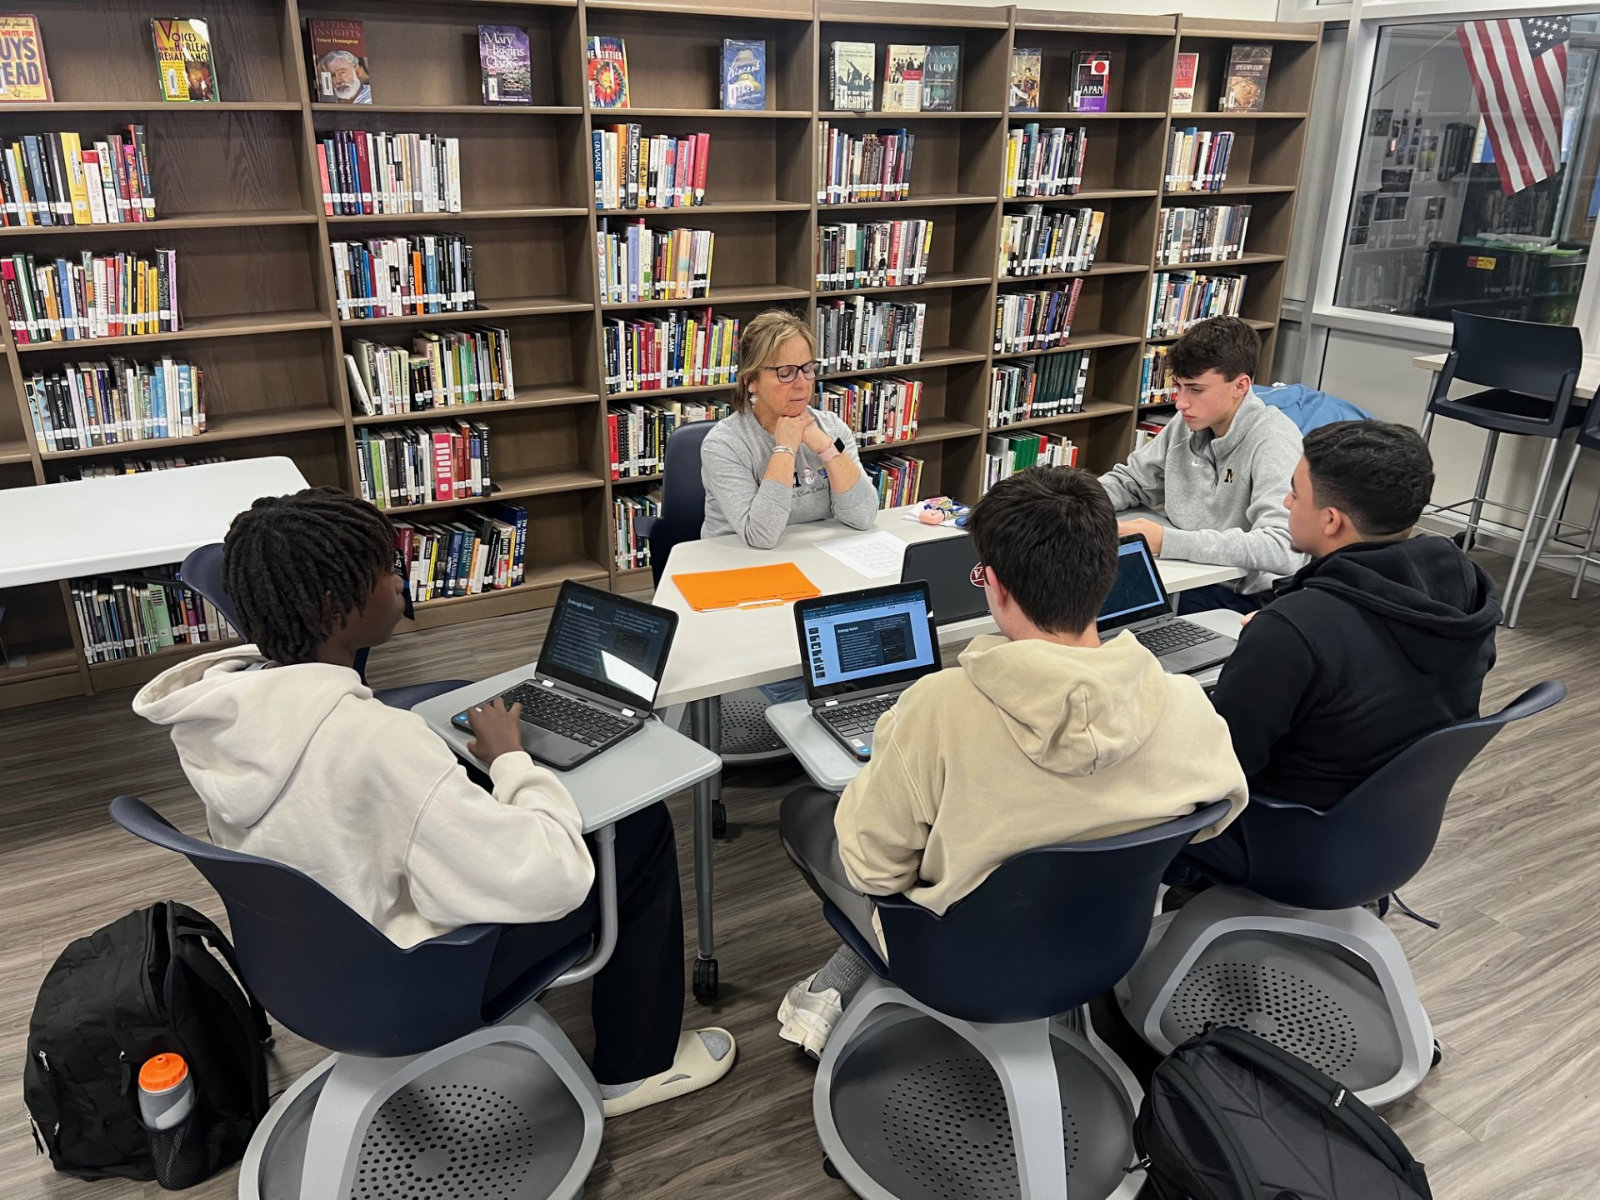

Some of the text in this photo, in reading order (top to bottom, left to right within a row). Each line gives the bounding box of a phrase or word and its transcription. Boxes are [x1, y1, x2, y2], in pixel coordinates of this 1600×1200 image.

[313, 27, 361, 38] INSIGHTS
[483, 31, 514, 48] Mary
[484, 43, 525, 61] Higgins
[926, 50, 958, 58] SAAC'S
[0, 61, 40, 87] EAD
[1079, 85, 1103, 95] JAPAN
[593, 140, 602, 173] CRUSADES
